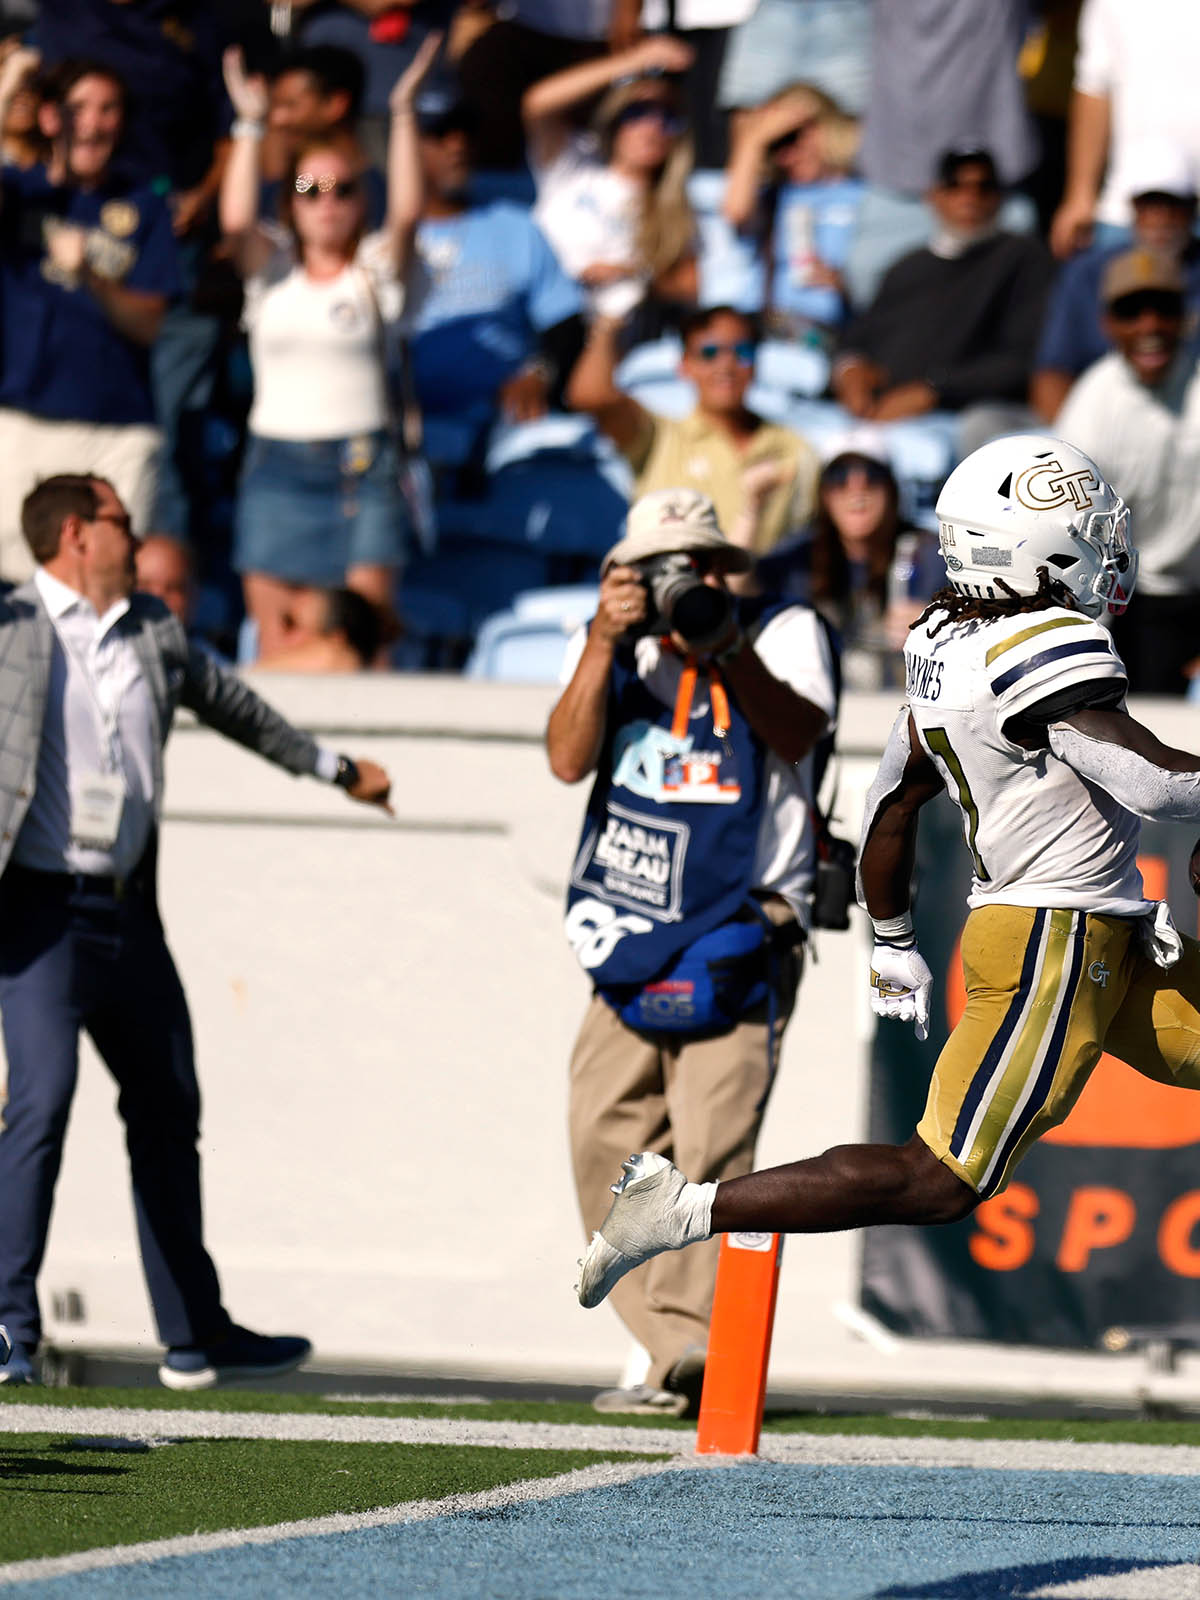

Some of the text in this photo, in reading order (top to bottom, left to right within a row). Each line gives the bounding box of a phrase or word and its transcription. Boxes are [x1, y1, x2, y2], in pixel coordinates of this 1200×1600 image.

[1015, 460, 1096, 512] GT
[906, 651, 945, 702] AYNES
[1088, 960, 1111, 988] GT
